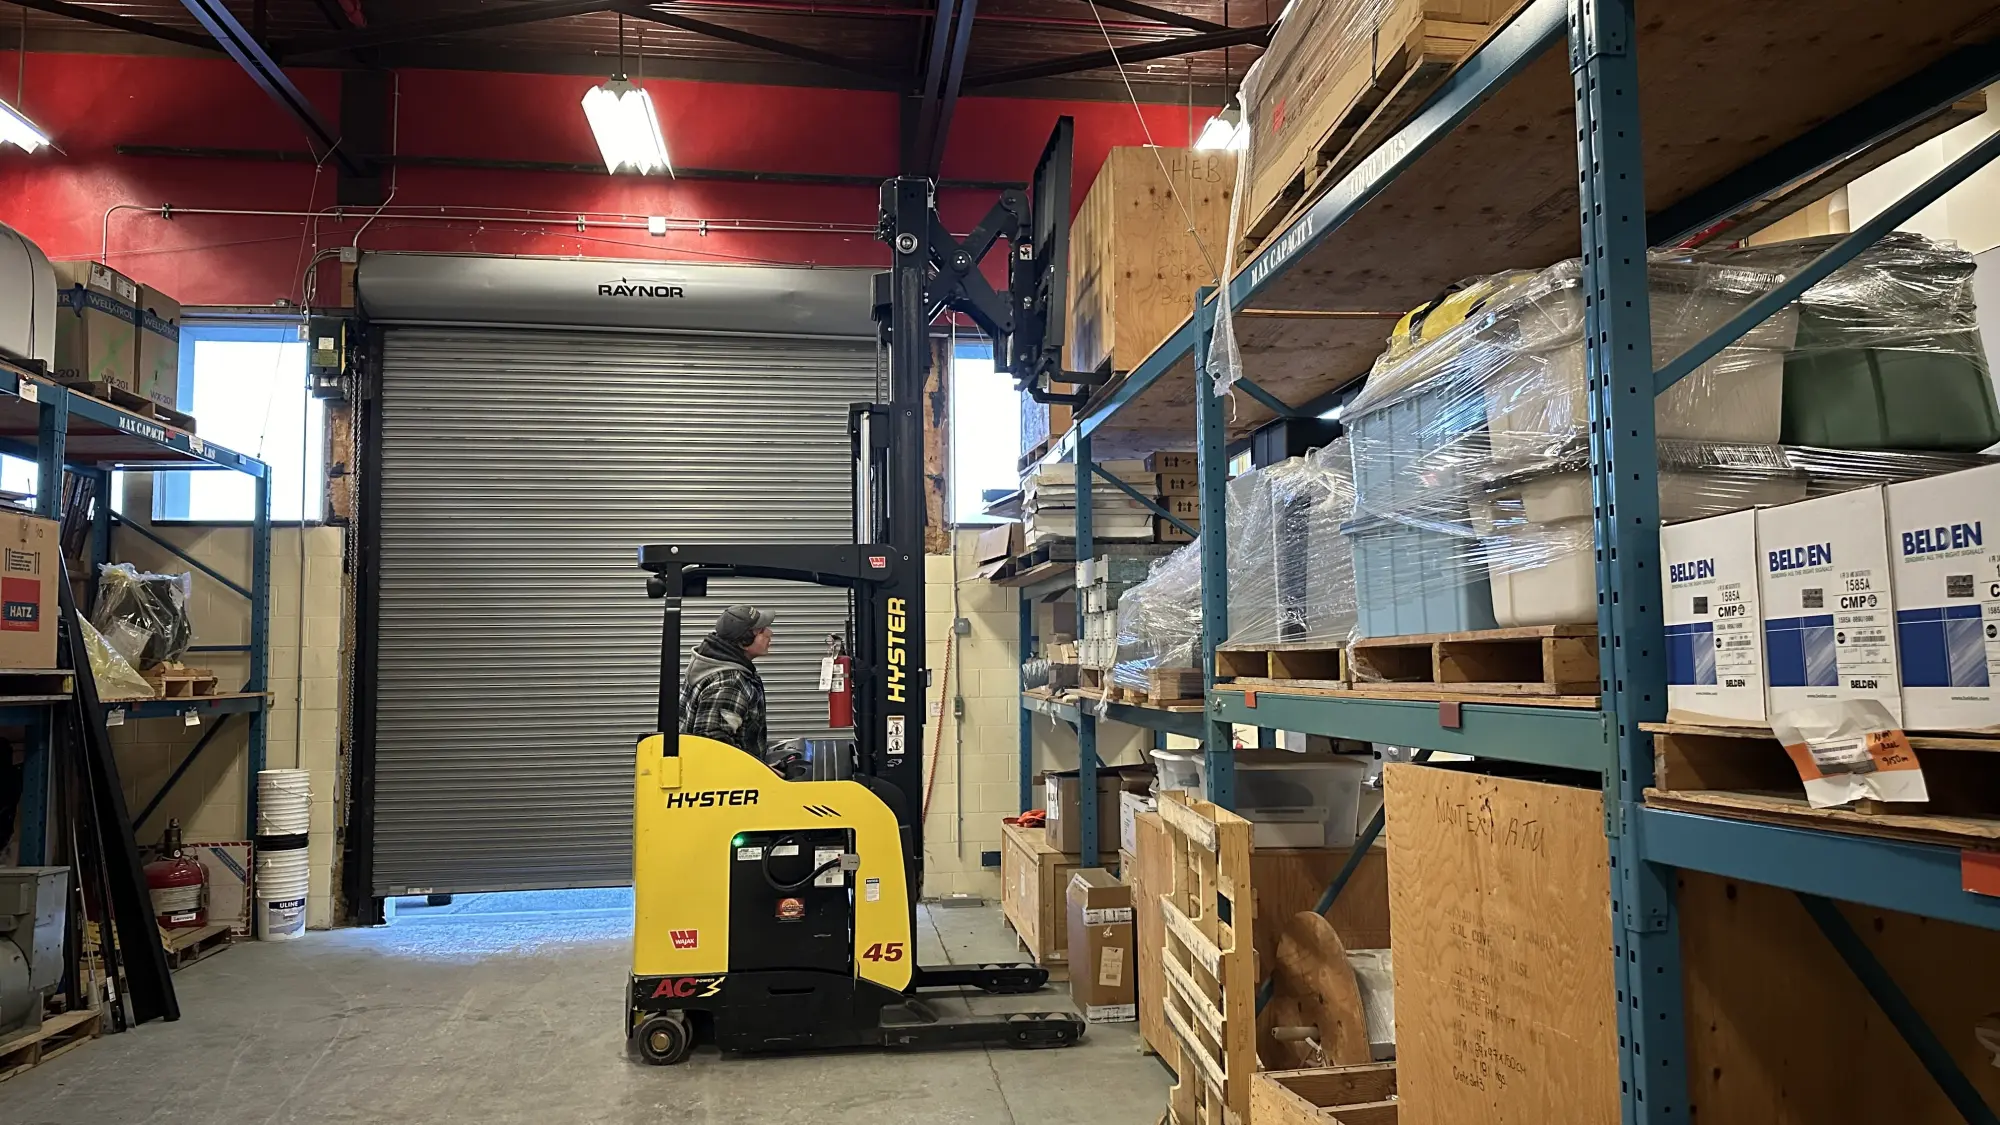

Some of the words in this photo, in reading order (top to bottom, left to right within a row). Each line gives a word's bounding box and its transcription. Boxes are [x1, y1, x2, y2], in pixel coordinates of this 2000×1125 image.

[1251, 255, 1269, 288] MAX
[1270, 213, 1314, 269] CAPACITY
[598, 284, 684, 298] RAYNOR
[101, 373, 129, 391] WX-201
[150, 391, 173, 406] WX-201
[119, 416, 135, 431] MAX
[1902, 521, 1982, 556] BELDEN
[1768, 542, 1832, 573] BELDEN
[1669, 558, 1715, 583] BELDEN
[1845, 578, 1871, 592] 1585A
[1721, 590, 1740, 602] 1585A
[1840, 595, 1867, 609] CMP
[9, 605, 32, 618] HATZ
[1718, 605, 1737, 617] CMP
[887, 597, 906, 703] HYSTER
[1725, 679, 1746, 688] BELDEN
[1850, 679, 1878, 689] BELDEN
[666, 789, 759, 809] HYSTER
[862, 943, 904, 962] 45
[650, 977, 697, 998] AC
